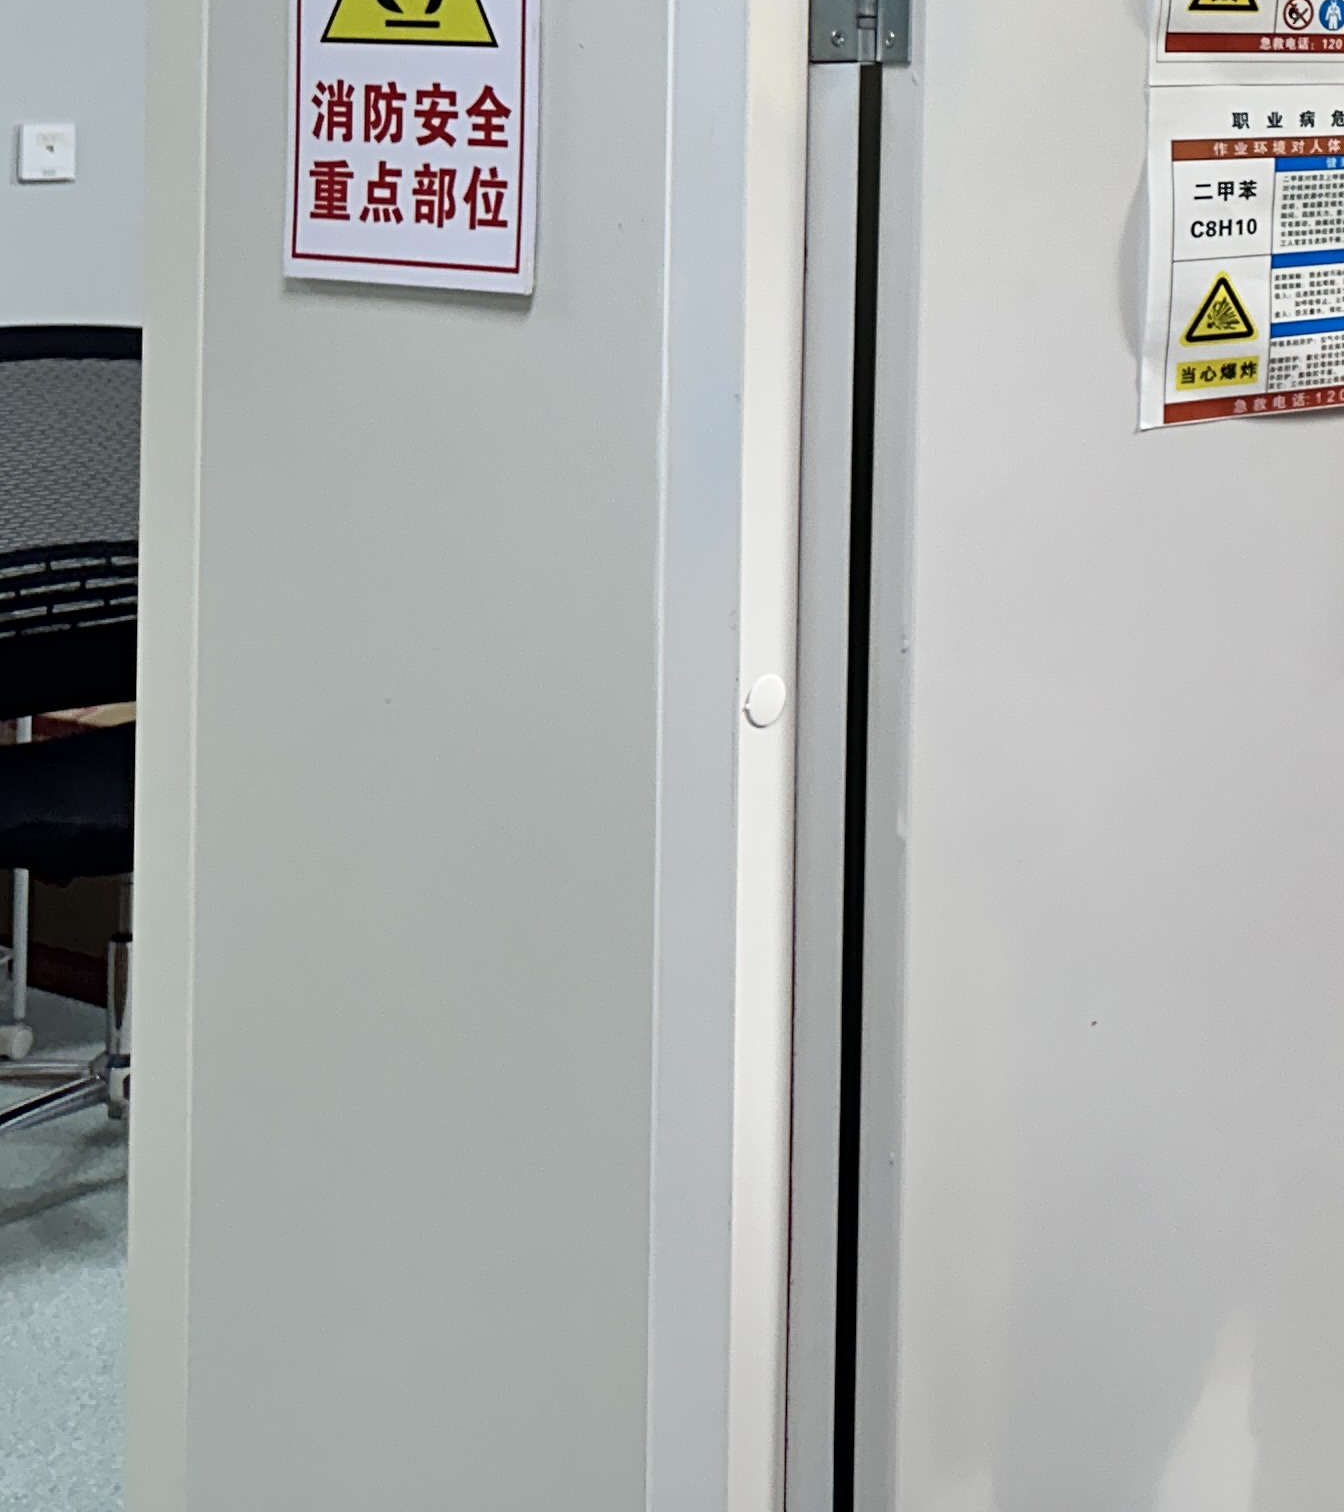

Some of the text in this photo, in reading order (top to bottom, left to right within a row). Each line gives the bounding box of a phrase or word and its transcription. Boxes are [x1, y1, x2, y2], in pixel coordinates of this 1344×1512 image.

[310, 78, 513, 149] 消防安全
[309, 159, 510, 231] 重点部位
[1193, 179, 1259, 202] 二甲苯
[1190, 218, 1258, 239] C8H10
[1180, 360, 1259, 385] 当心爆炸
